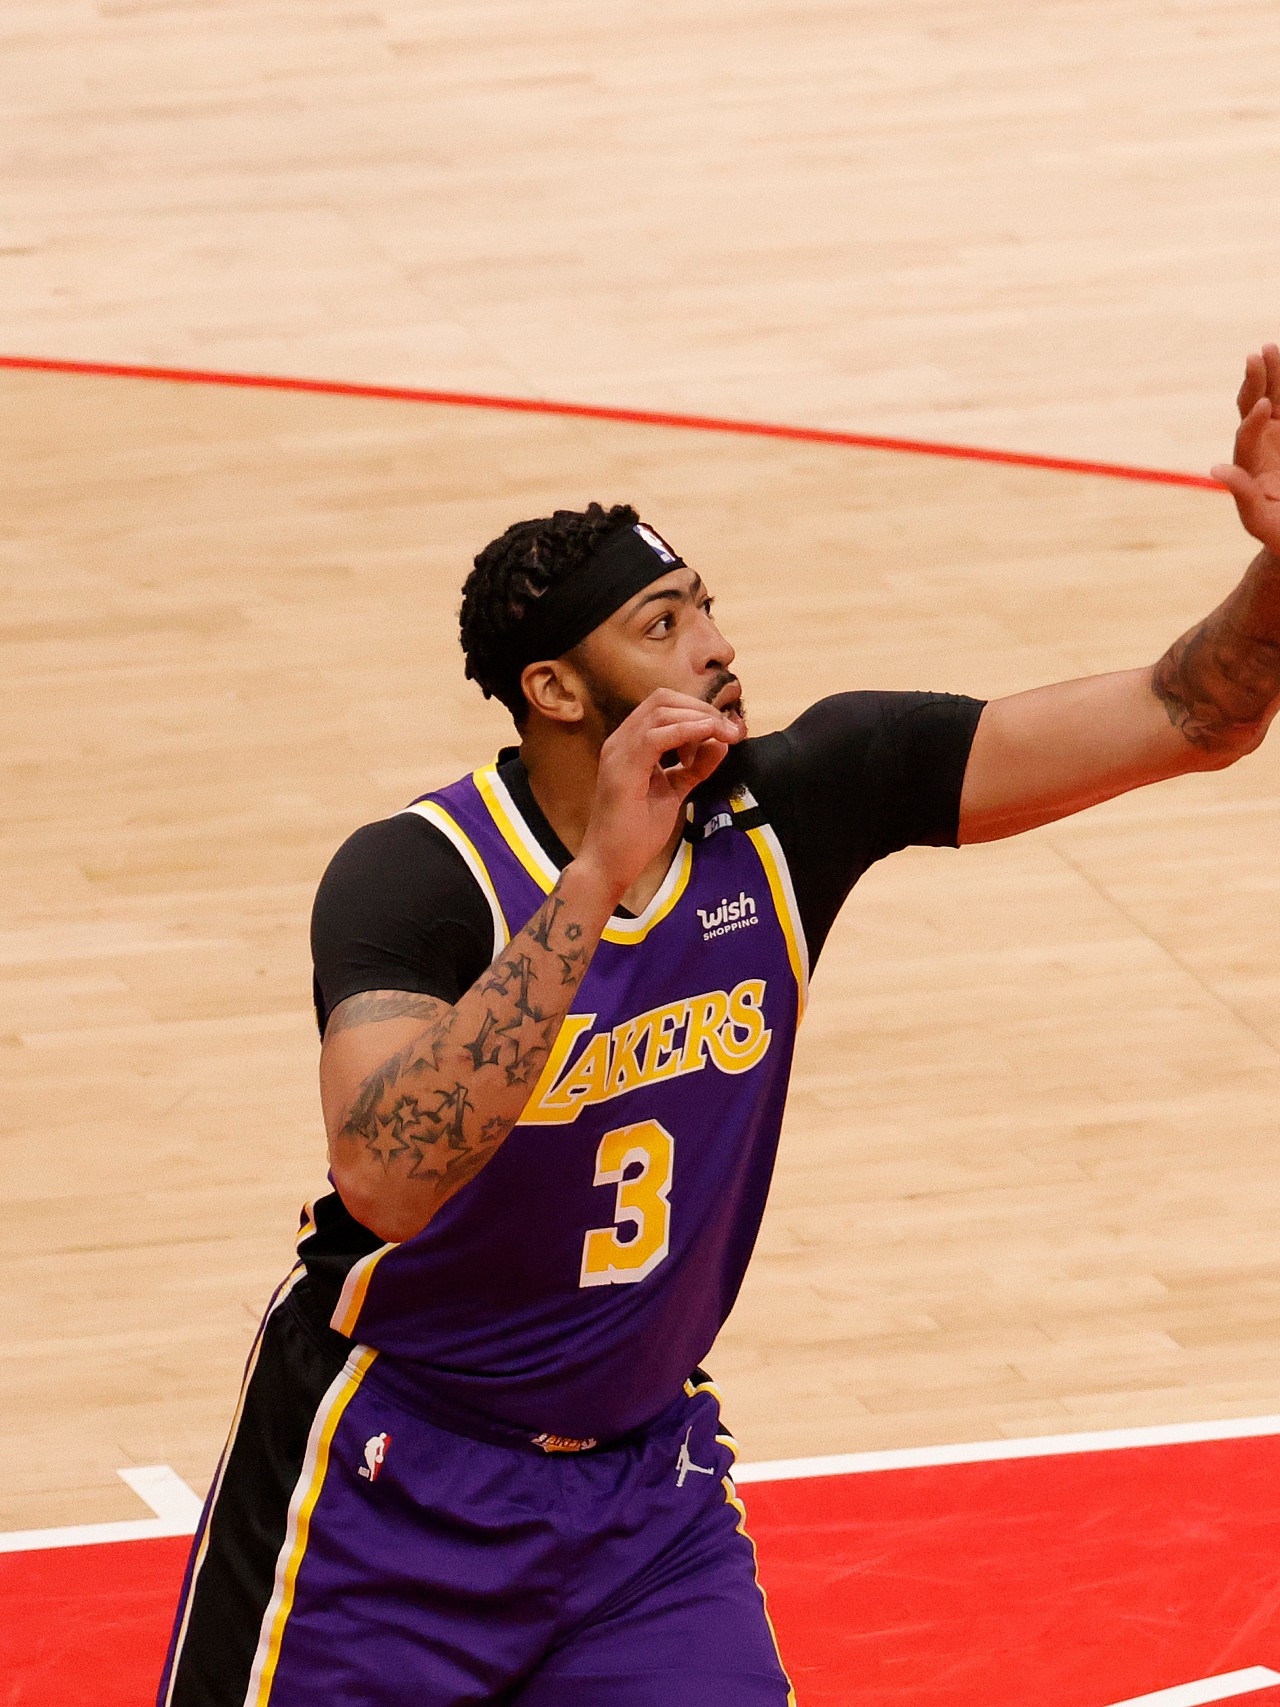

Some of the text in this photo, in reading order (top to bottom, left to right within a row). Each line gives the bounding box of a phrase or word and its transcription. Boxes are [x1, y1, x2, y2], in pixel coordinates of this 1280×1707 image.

[696, 891, 756, 929] wish
[703, 916, 759, 941] SHOPPING
[514, 979, 772, 1126] LAKERS
[579, 1118, 675, 1288] 3
